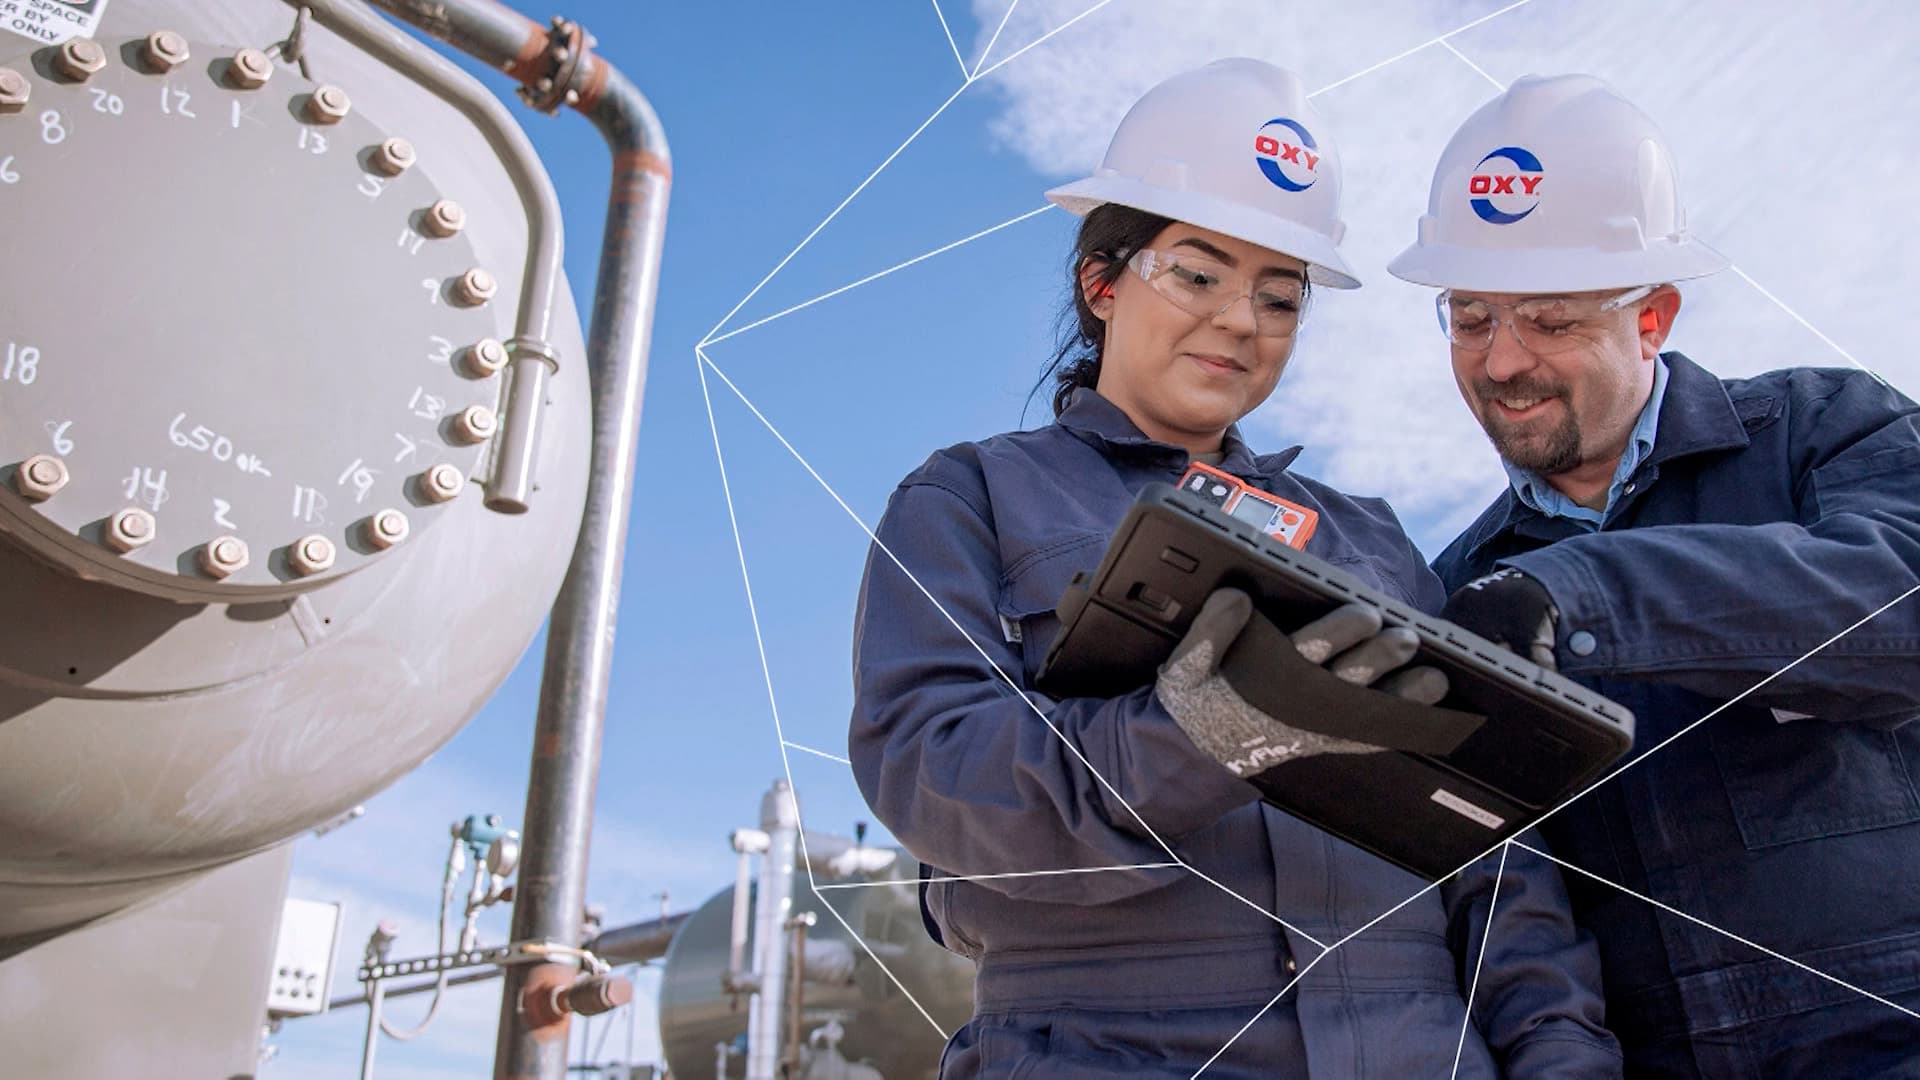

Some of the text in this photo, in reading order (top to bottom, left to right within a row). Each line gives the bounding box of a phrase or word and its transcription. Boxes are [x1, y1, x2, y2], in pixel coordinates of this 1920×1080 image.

[12, 19, 59, 40] ONLY
[25, 9, 49, 23] BY
[89, 87, 124, 115] 20
[161, 84, 196, 119] 12
[39, 110, 66, 144] 8
[1255, 134, 1320, 173] OXY
[1469, 175, 1544, 195] OXY
[3, 342, 41, 385] 18
[168, 412, 233, 462] 650
